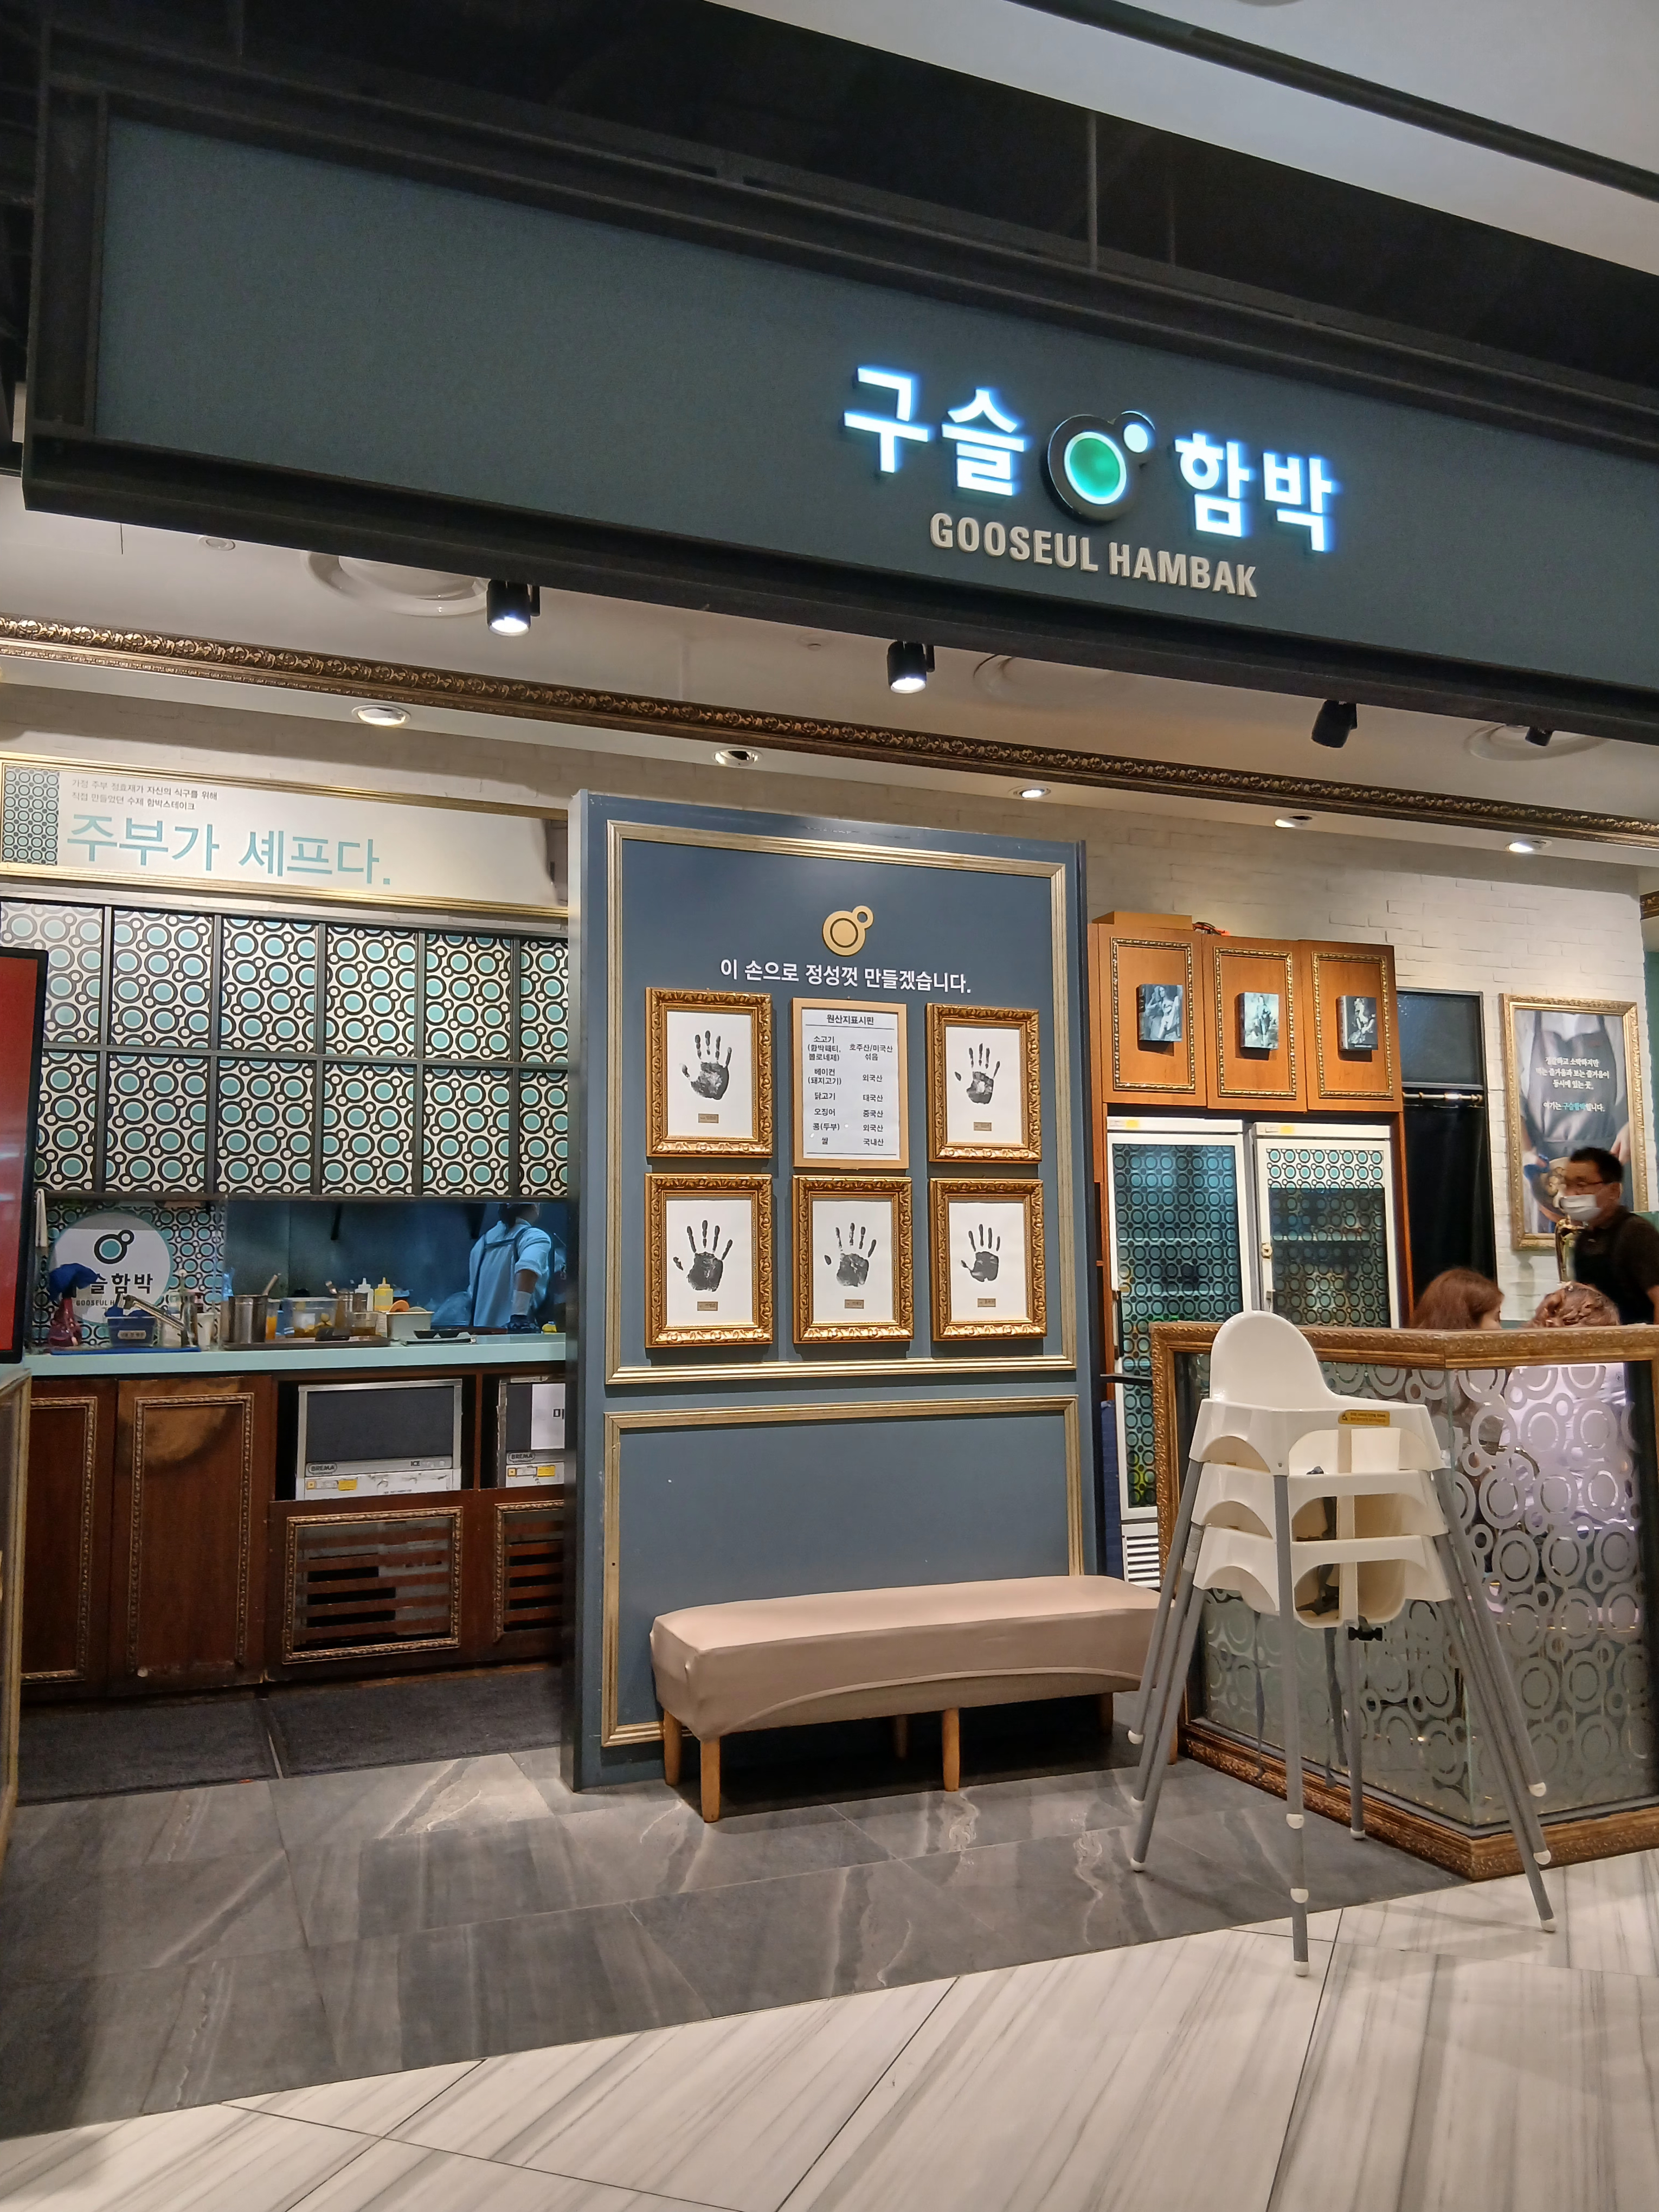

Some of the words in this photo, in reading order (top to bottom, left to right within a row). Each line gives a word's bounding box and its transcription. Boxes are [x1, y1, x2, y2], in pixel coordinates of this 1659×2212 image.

[844, 366, 1025, 497] 구슬
[1174, 433, 1332, 552] 함박
[930, 512, 1098, 572] GOOSEUL
[1108, 542, 1257, 597] HAMBAK
[72, 779, 88, 788] 가정
[91, 780, 108, 790] 주부
[147, 787, 171, 795] 자신의
[175, 788, 198, 799] 식구를
[202, 791, 217, 800] 위해
[72, 792, 88, 801] 직접
[91, 794, 124, 804] 만들었던
[127, 797, 144, 806] 수제
[147, 799, 195, 810] 함박스테이크
[67, 814, 220, 871] 주부가
[237, 830, 390, 885] 셰프다.
[720, 959, 738, 980] 이
[744, 960, 799, 982] 손으로
[805, 964, 858, 987] 정성껏
[864, 967, 972, 993] 만들겠습니다.
[813, 1036, 835, 1044] 소고기
[849, 1043, 893, 1053] 호주산/미국산
[865, 1053, 878, 1061] 섞음
[814, 1068, 835, 1076] 베이컨
[808, 1077, 842, 1085] (돼지고기)
[862, 1074, 883, 1082] 외국산
[814, 1092, 836, 1101] 닭고기
[863, 1094, 884, 1102] 태국산
[1543, 1102, 1562, 1110] 여기는
[863, 1109, 884, 1117] 중국산
[813, 1123, 840, 1131] 콩(두부)
[821, 1137, 828, 1145] 쌀
[863, 1138, 884, 1146] 국내산
[90, 1273, 153, 1294] 슬함박
